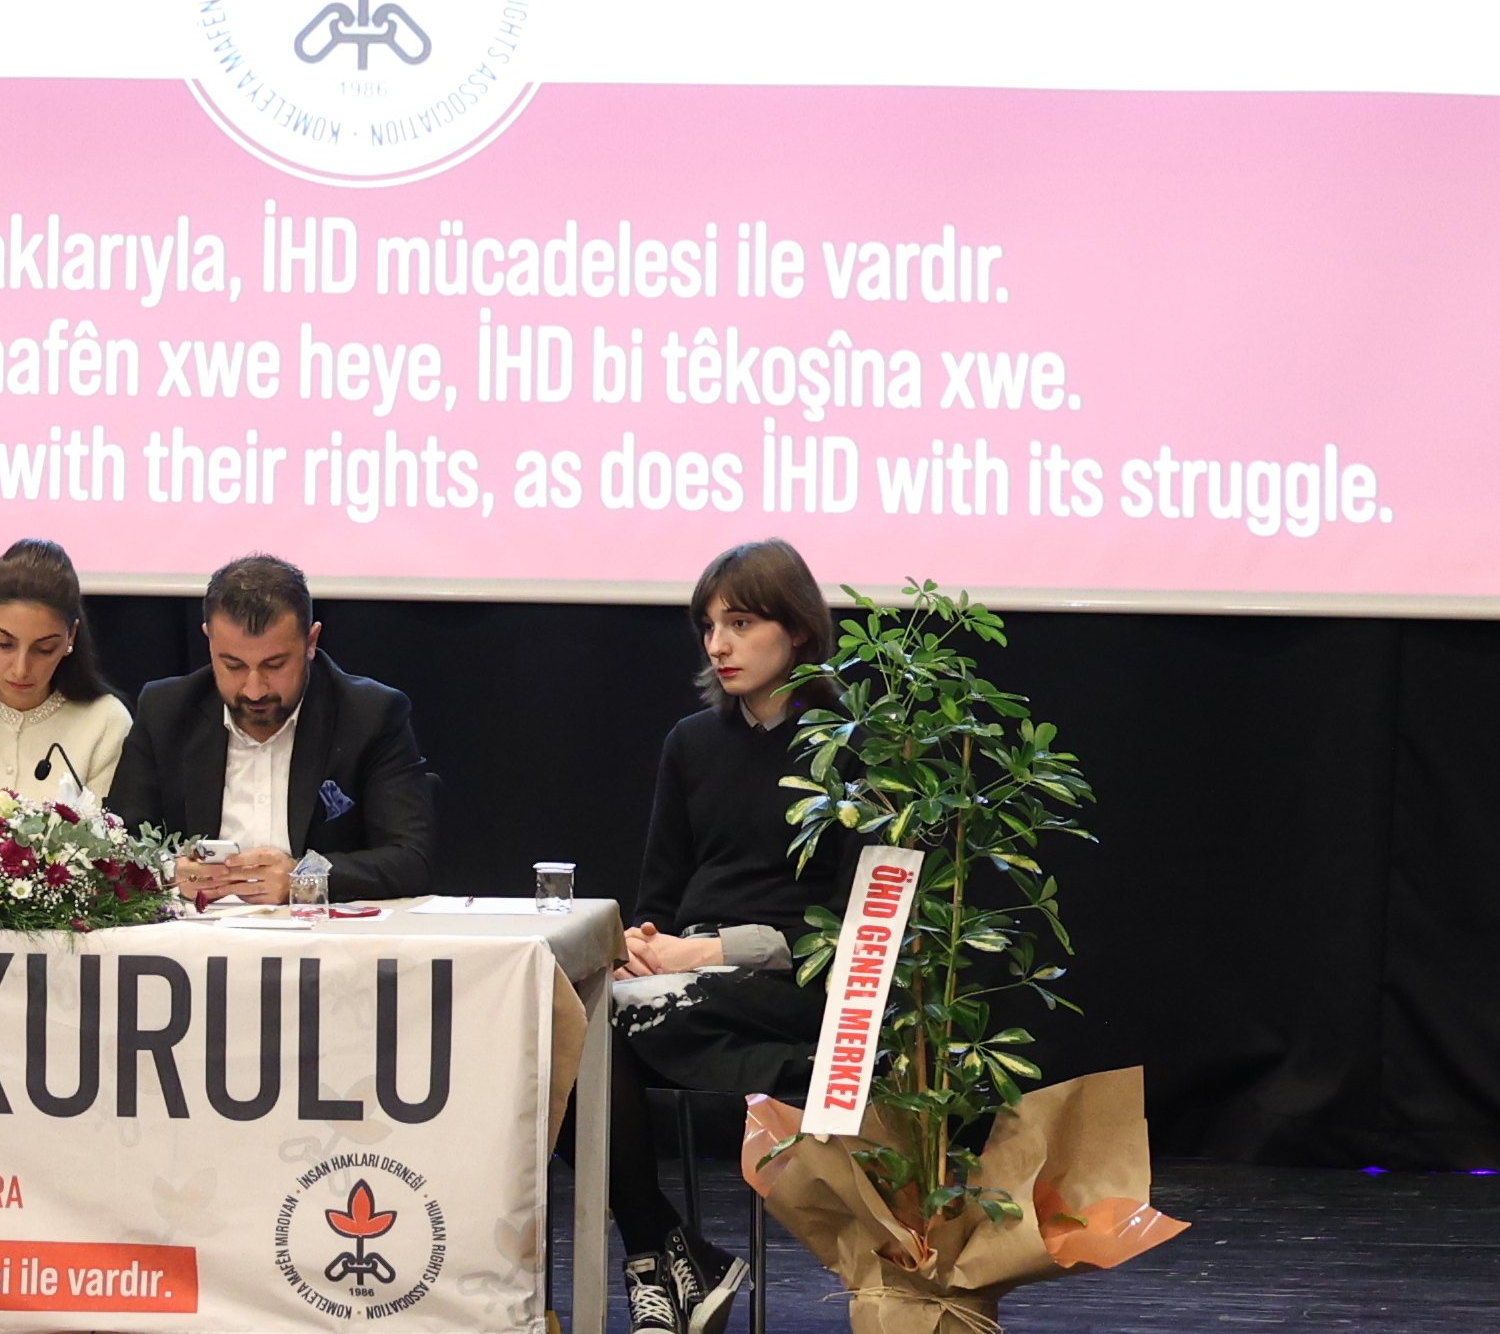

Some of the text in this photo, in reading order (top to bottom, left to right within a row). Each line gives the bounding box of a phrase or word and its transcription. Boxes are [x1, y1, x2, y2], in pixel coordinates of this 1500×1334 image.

[235, 67, 342, 145] KOMELEYA
[338, 80, 389, 98] 1986
[369, 61, 500, 147] ASSOCIATION
[262, 199, 358, 295] İHD
[376, 219, 718, 298] mücadelesi
[736, 223, 805, 298] ile
[822, 224, 1010, 303] vardır.
[156, 340, 281, 399] xwe
[299, 323, 457, 417] heye,
[478, 308, 574, 403] İHD
[592, 325, 644, 404] bi
[660, 327, 922, 422] têkoşîna
[939, 351, 1082, 411] xwe.
[142, 426, 287, 505] their
[303, 429, 495, 524] rights,
[513, 449, 583, 509] as
[600, 431, 744, 513] does
[762, 417, 859, 514] İHD
[876, 437, 1009, 516] with
[1028, 439, 1104, 518] its
[1120, 443, 1393, 538] struggle.
[824, 864, 914, 1112] ÖHD GENEL MERKEZ
[296, 1153, 428, 1192] İNSAN HAKLARI DERNEĞİ
[275, 1195, 300, 1247] MIROVAN
[366, 1200, 447, 1320] HUMAN RIGHTS ASSOCIATION
[20, 1260, 59, 1297] ile
[68, 1261, 173, 1299] vardır.
[298, 1281, 352, 1320] KOMELEYA
[348, 1287, 375, 1297] 1986
